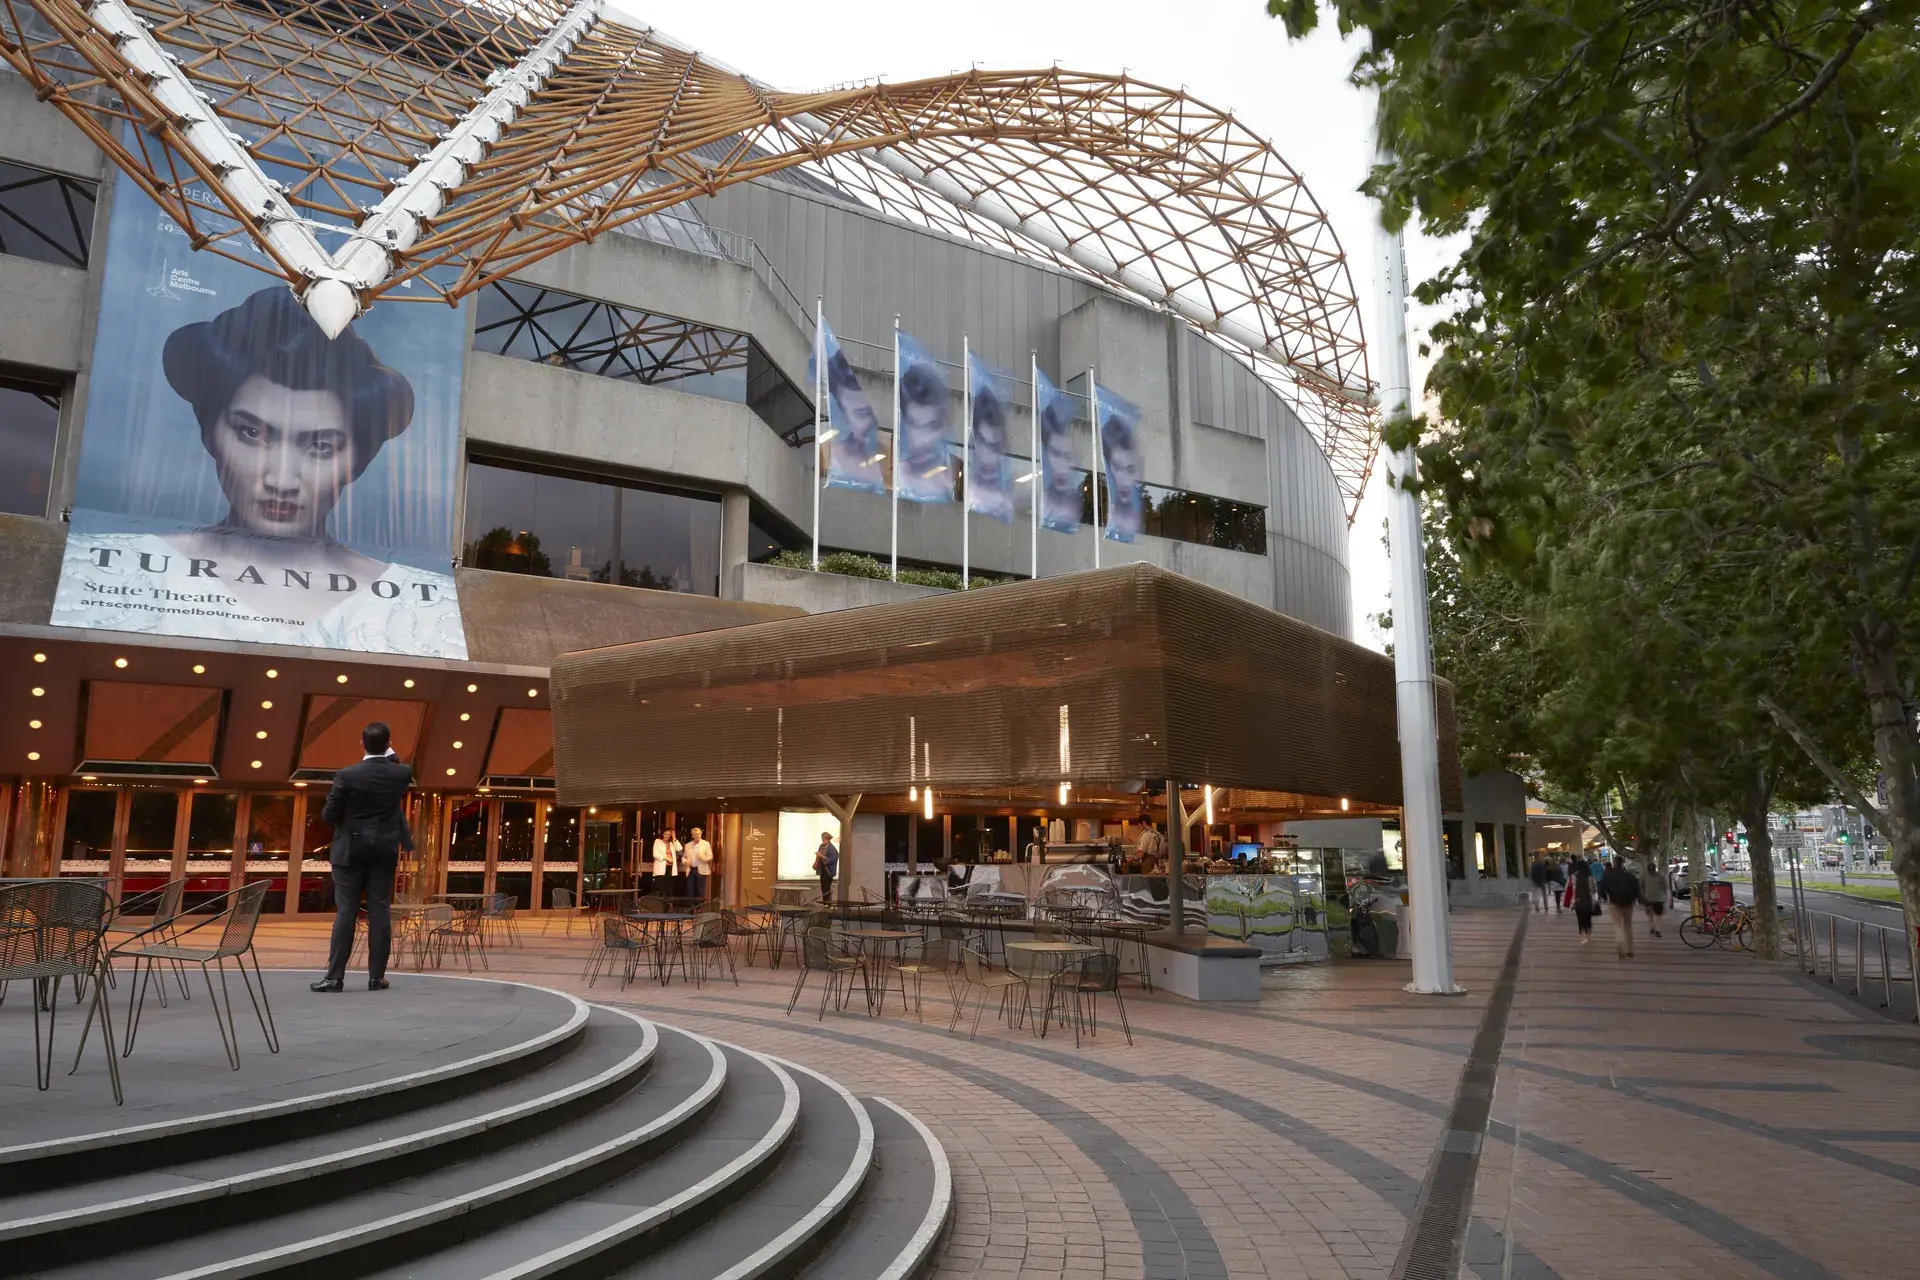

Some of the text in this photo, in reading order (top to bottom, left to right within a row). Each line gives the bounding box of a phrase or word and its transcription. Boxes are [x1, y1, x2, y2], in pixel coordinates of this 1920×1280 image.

[169, 187, 223, 206] PERA
[170, 274, 200, 286] Centre
[171, 268, 189, 277] Arts
[170, 280, 217, 296] Melbourne
[89, 547, 438, 602] TURANDOT
[83, 581, 238, 606] State Theatre
[80, 598, 305, 627] artscentremelbourne.com.au
